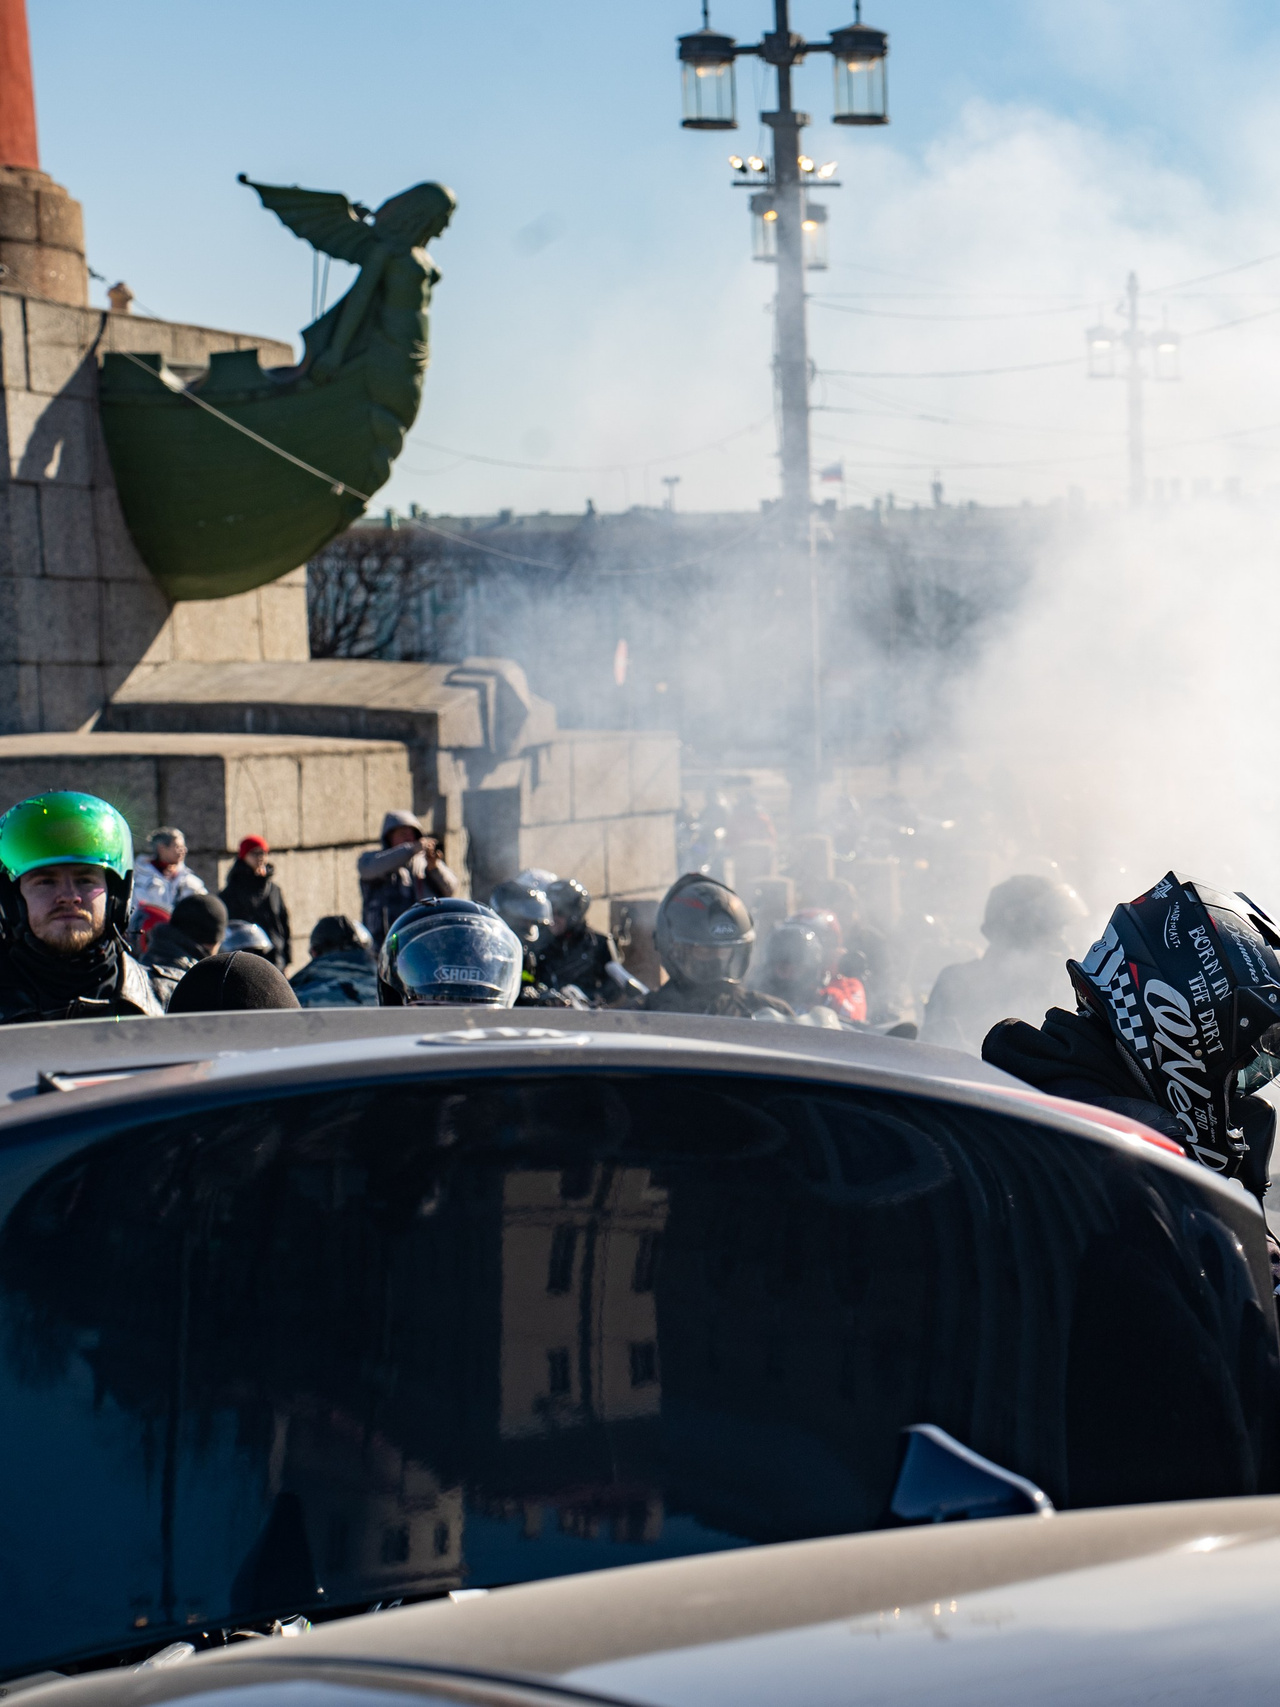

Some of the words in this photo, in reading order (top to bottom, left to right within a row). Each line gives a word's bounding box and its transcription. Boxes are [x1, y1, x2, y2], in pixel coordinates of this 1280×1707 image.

[1188, 925, 1223, 976] BORN
[1211, 977, 1233, 1001] IN
[1222, 921, 1260, 984] Demons
[441, 968, 480, 981] SHOEI
[1188, 971, 1211, 1006] THE
[1198, 1008, 1224, 1054] DIRT
[1194, 1106, 1209, 1130] 1970
